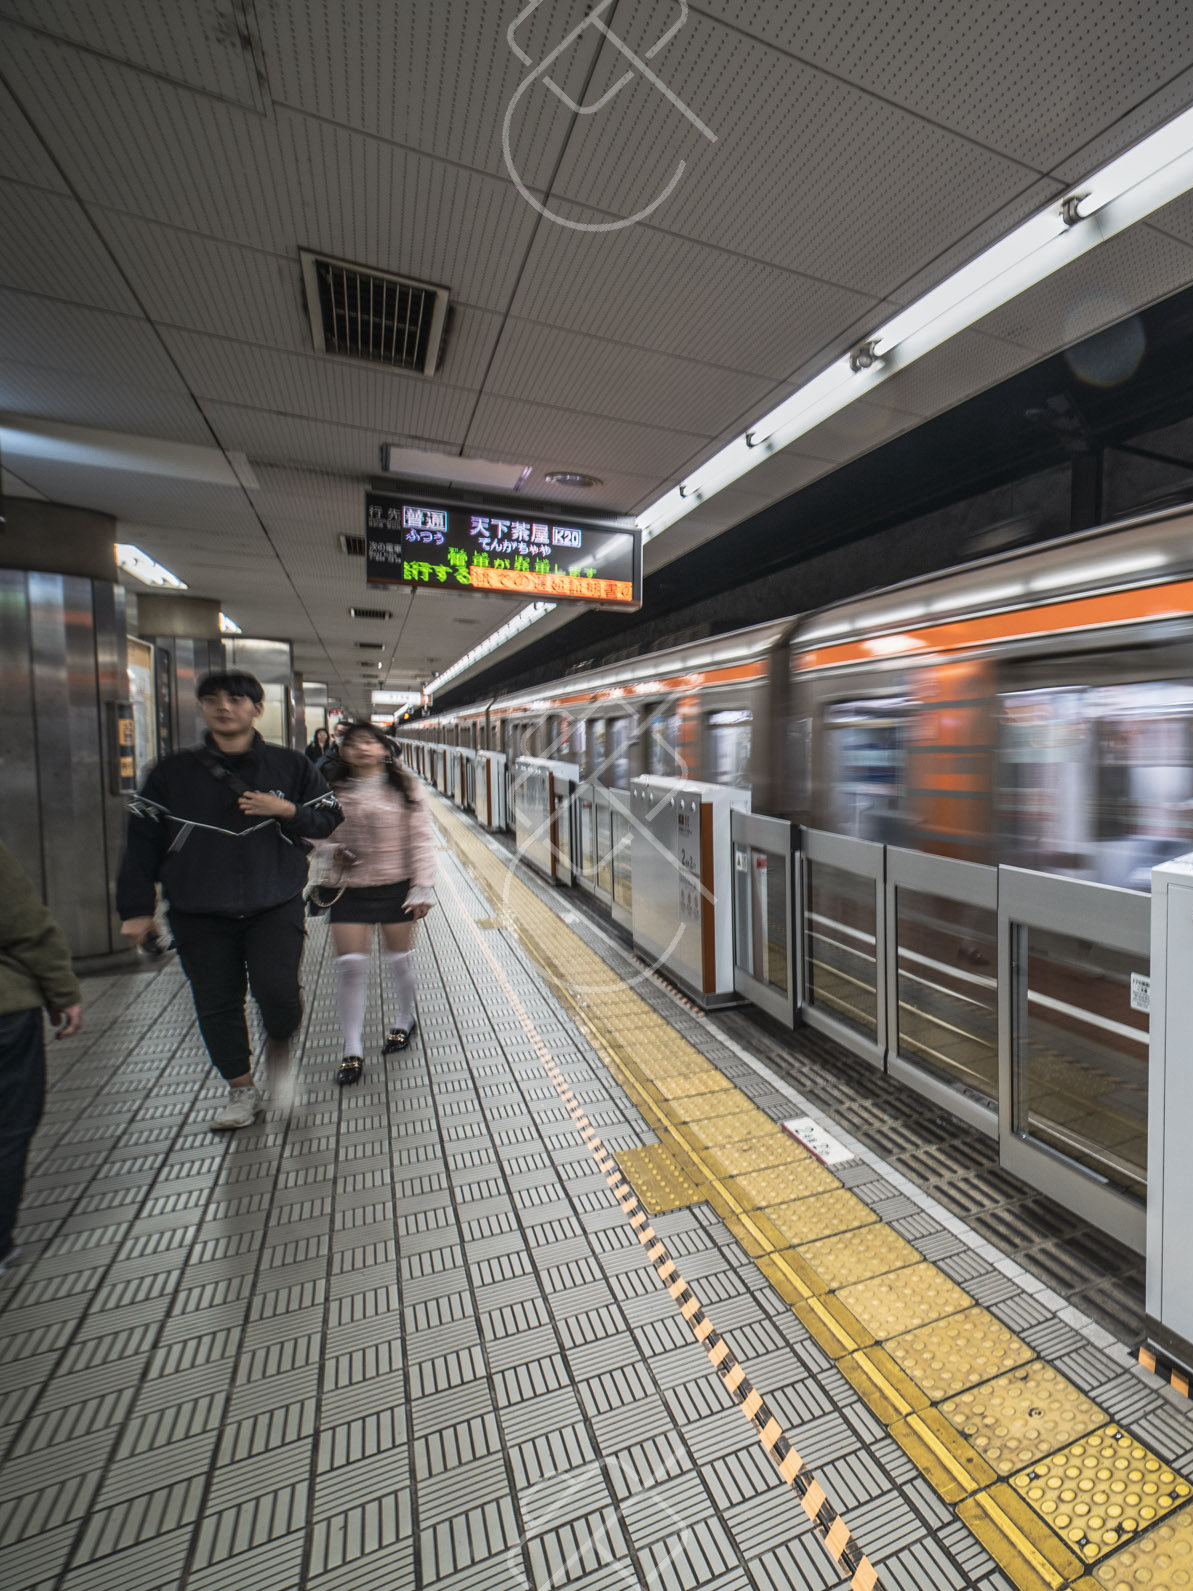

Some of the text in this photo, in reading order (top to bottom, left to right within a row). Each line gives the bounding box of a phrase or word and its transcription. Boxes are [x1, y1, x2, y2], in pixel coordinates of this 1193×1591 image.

[405, 508, 444, 531] 普通
[470, 516, 550, 544] 天下茶屋
[554, 528, 580, 547] K20
[405, 528, 446, 545] ふつう
[478, 537, 552, 557] てんがちゃや
